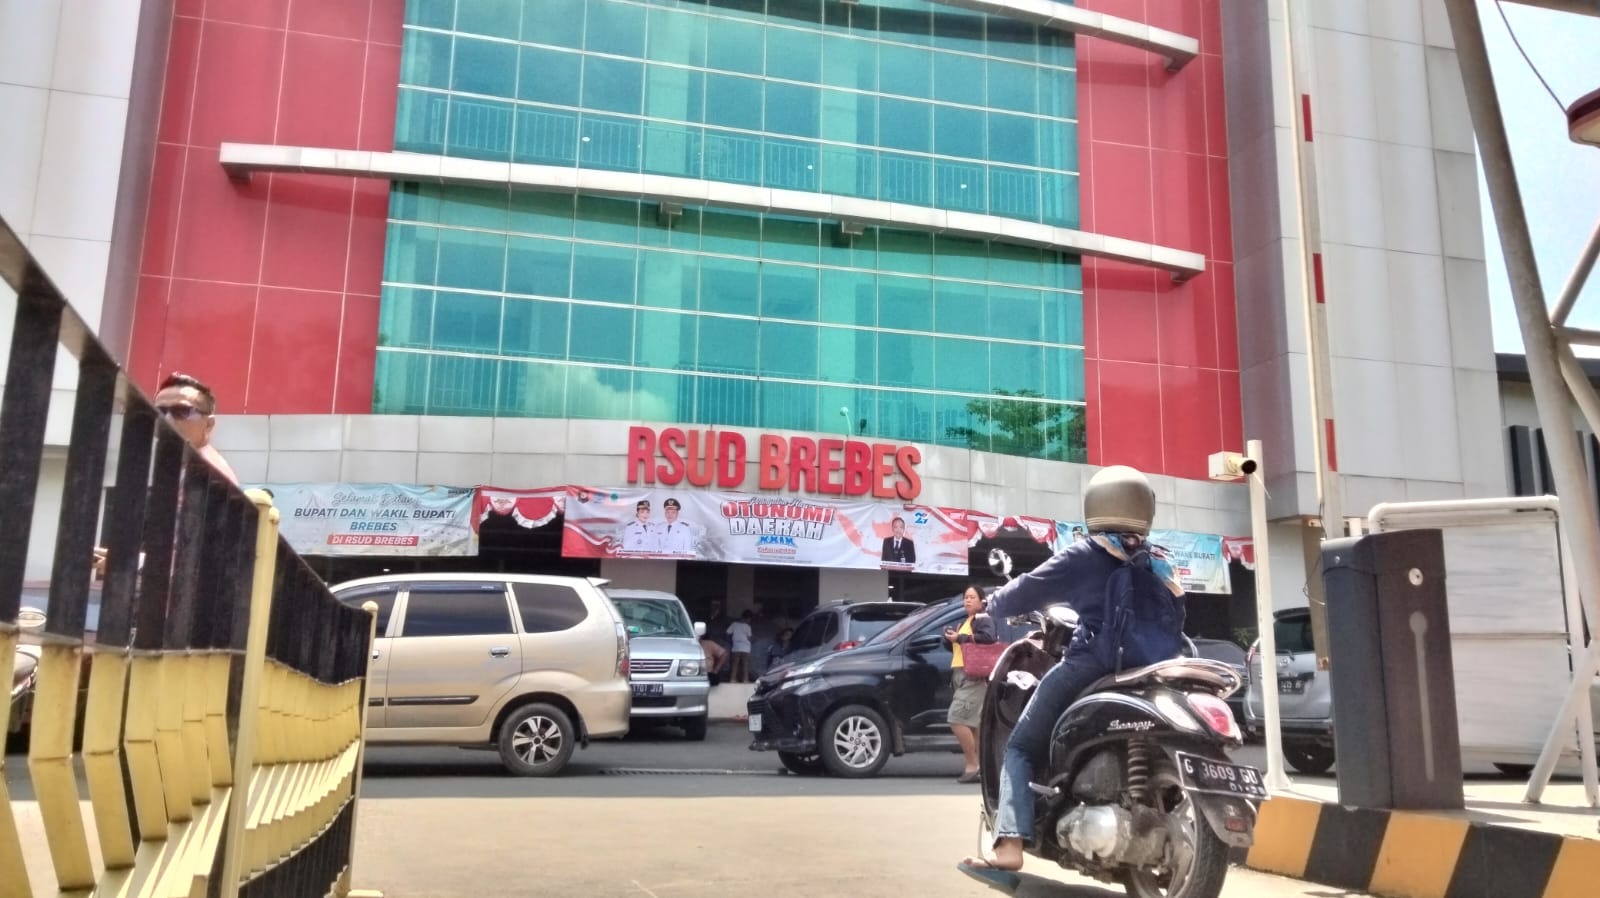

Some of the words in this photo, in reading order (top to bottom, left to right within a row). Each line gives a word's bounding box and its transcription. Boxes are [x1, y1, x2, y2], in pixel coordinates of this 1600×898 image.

[627, 426, 746, 488] RSUD
[760, 434, 922, 499] BREBES
[294, 508, 338, 517] BUPATI
[340, 508, 366, 517] DAN
[371, 508, 409, 519] WAKIL
[412, 509, 456, 519] BUPATI
[721, 500, 835, 525] OTONOMI
[350, 521, 398, 531] BREBES
[729, 518, 825, 540] DAERAH
[332, 535, 342, 545] DI
[344, 535, 372, 545] RSUD
[374, 536, 414, 546] BREBES
[1184, 758, 1194, 774] G
[1201, 762, 1236, 781] 3609
